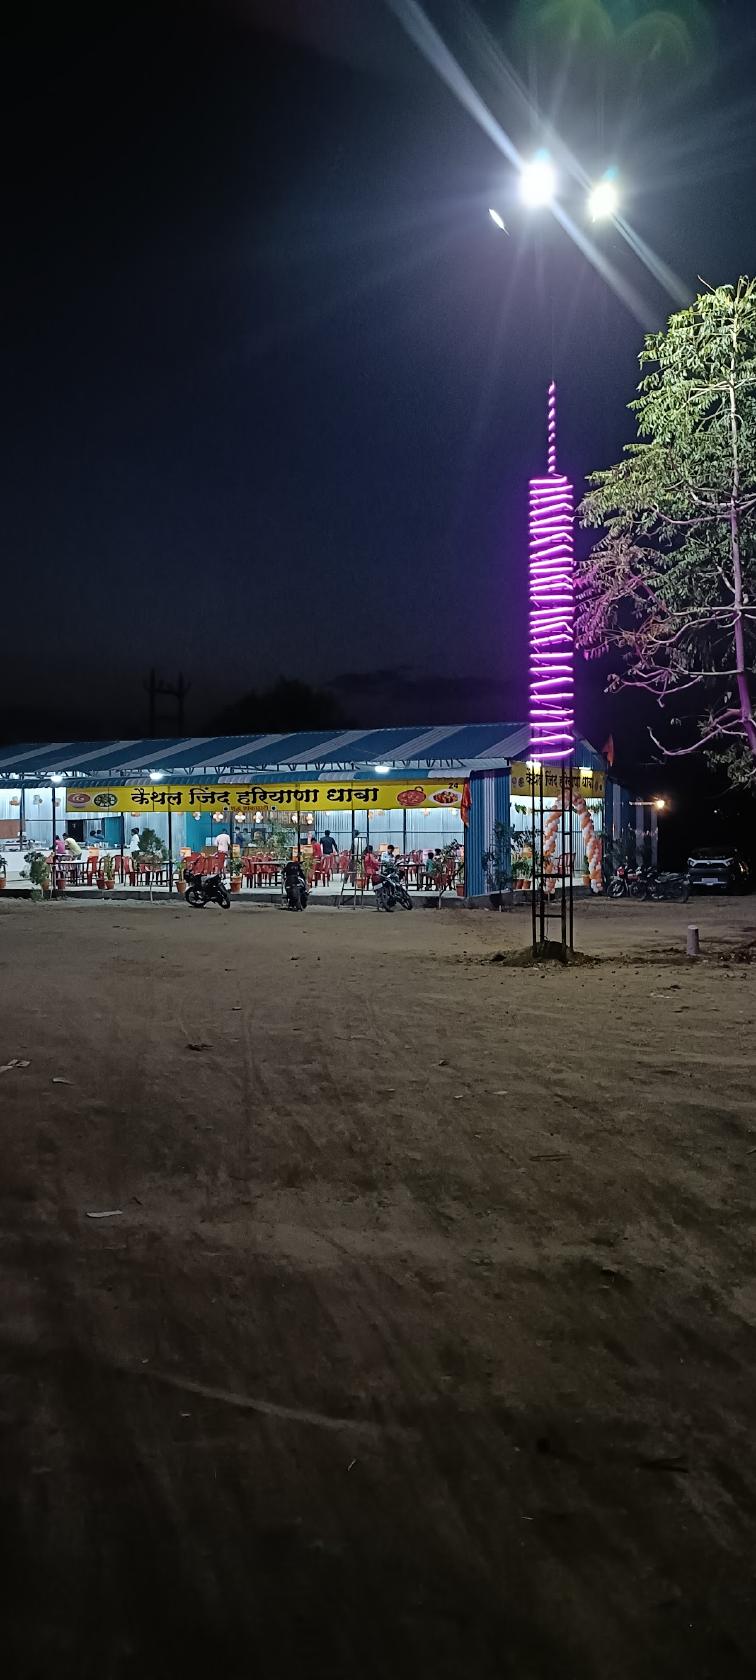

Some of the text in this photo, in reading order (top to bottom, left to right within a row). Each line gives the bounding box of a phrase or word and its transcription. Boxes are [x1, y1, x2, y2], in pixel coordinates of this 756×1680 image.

[131, 786, 379, 806] कैथल जिंद हरियाणा धाबा
